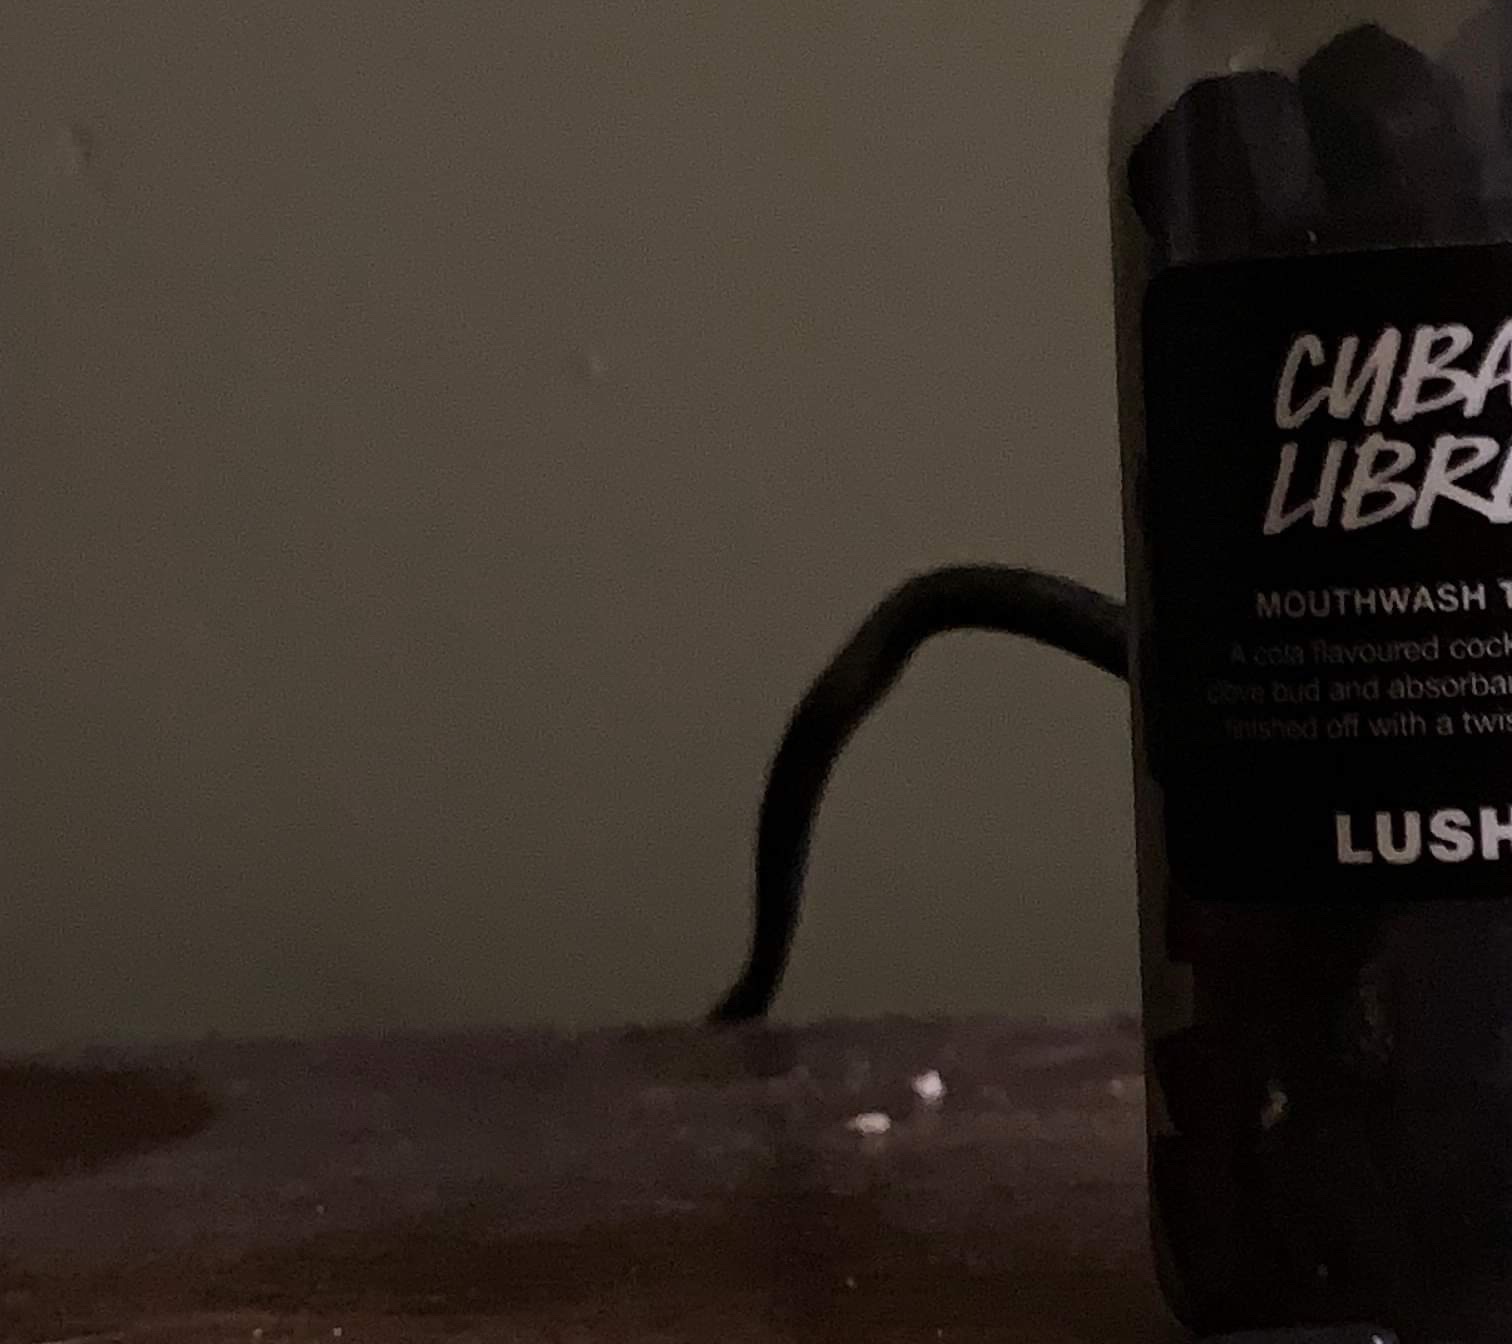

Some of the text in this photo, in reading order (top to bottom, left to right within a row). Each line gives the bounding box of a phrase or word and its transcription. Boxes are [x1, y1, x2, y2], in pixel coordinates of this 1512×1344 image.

[1256, 583, 1486, 619] MOUTHWASH
[1229, 646, 1246, 664] A
[1313, 635, 1439, 664] flavoured
[1273, 679, 1320, 703] bud
[1330, 676, 1380, 701] and
[1327, 711, 1360, 738] off
[1369, 709, 1426, 736] with
[1437, 714, 1453, 735] a
